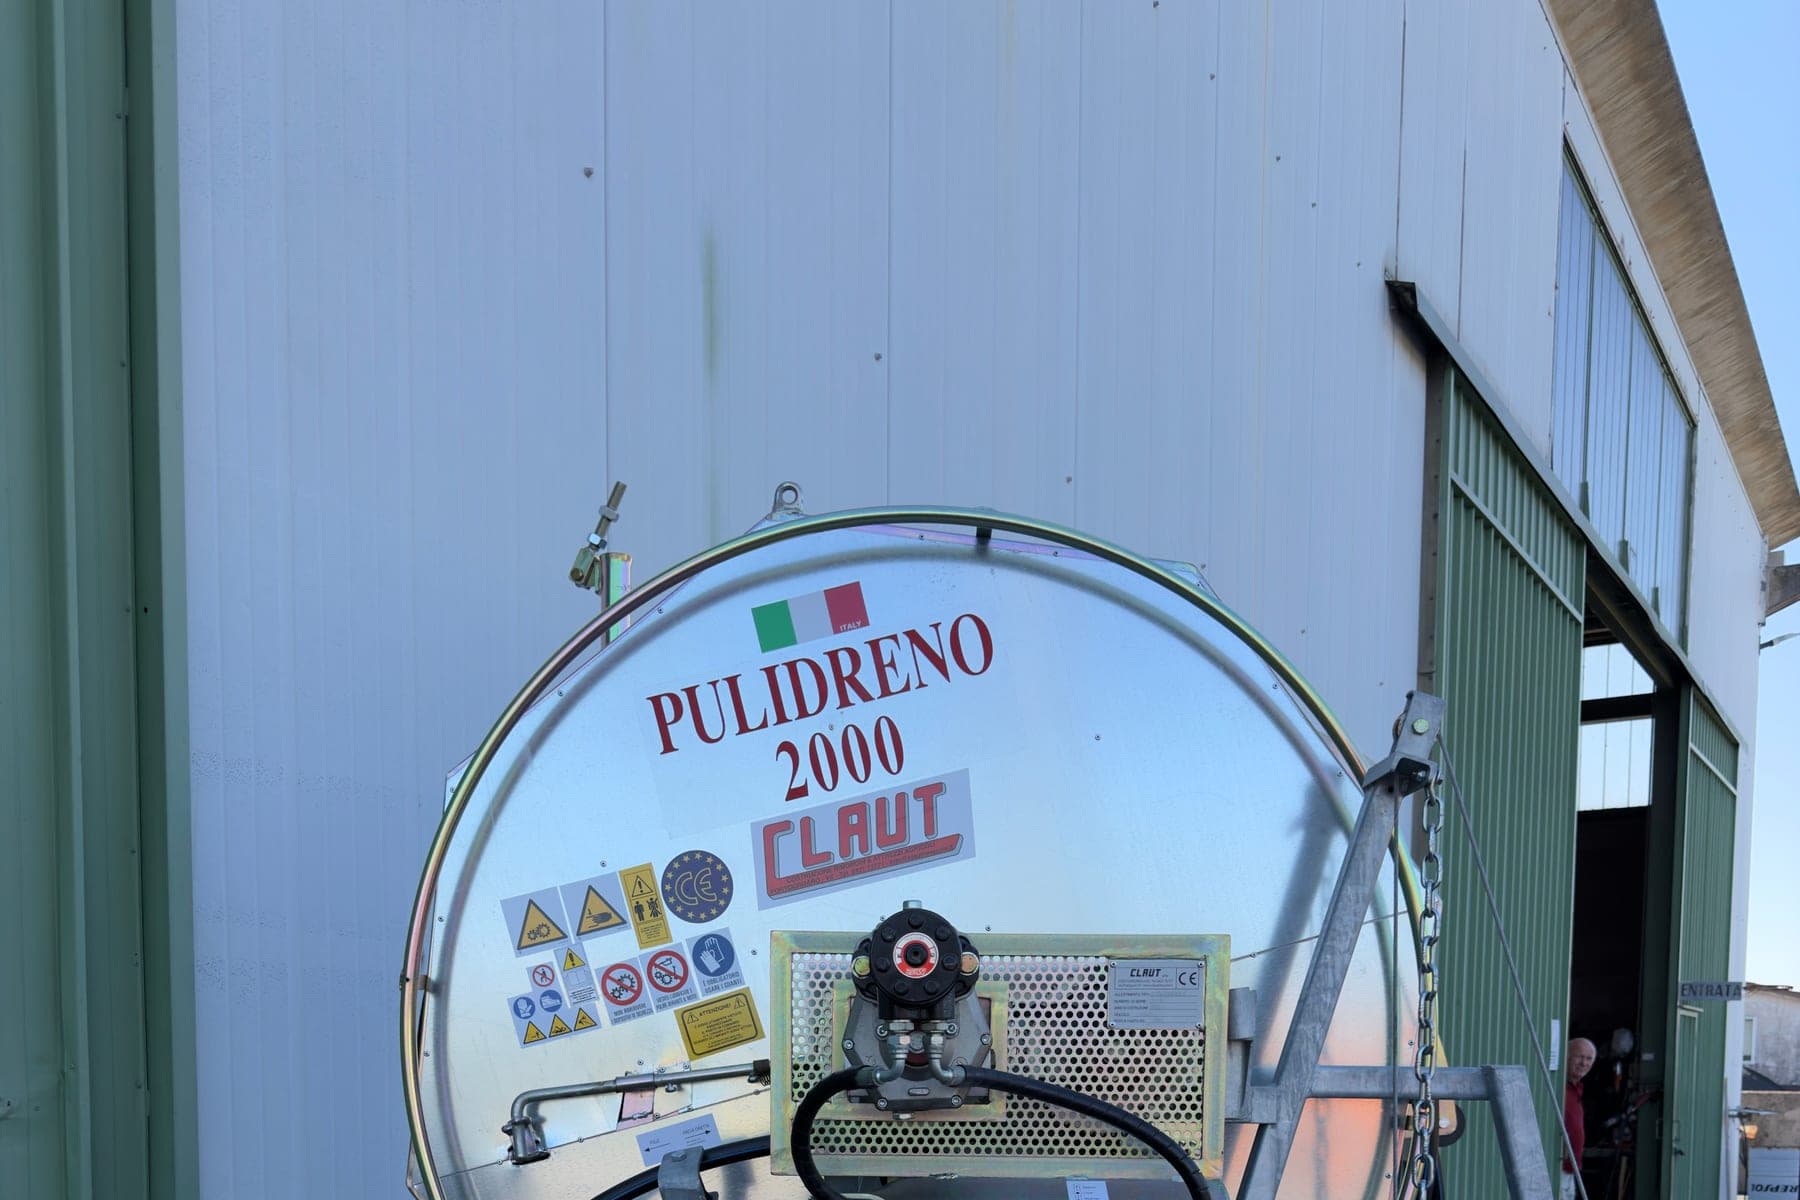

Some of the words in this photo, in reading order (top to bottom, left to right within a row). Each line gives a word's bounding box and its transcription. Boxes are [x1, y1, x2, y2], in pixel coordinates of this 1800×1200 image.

[839, 619, 862, 632] ITALY
[645, 613, 994, 755] PULIDRENO
[775, 715, 904, 802] 2000
[762, 781, 964, 901] CLAUT
[674, 866, 718, 906] CE
[1129, 968, 1162, 978] CLAUT
[1178, 971, 1198, 986] CE
[1680, 983, 1742, 997] ENTRATA
